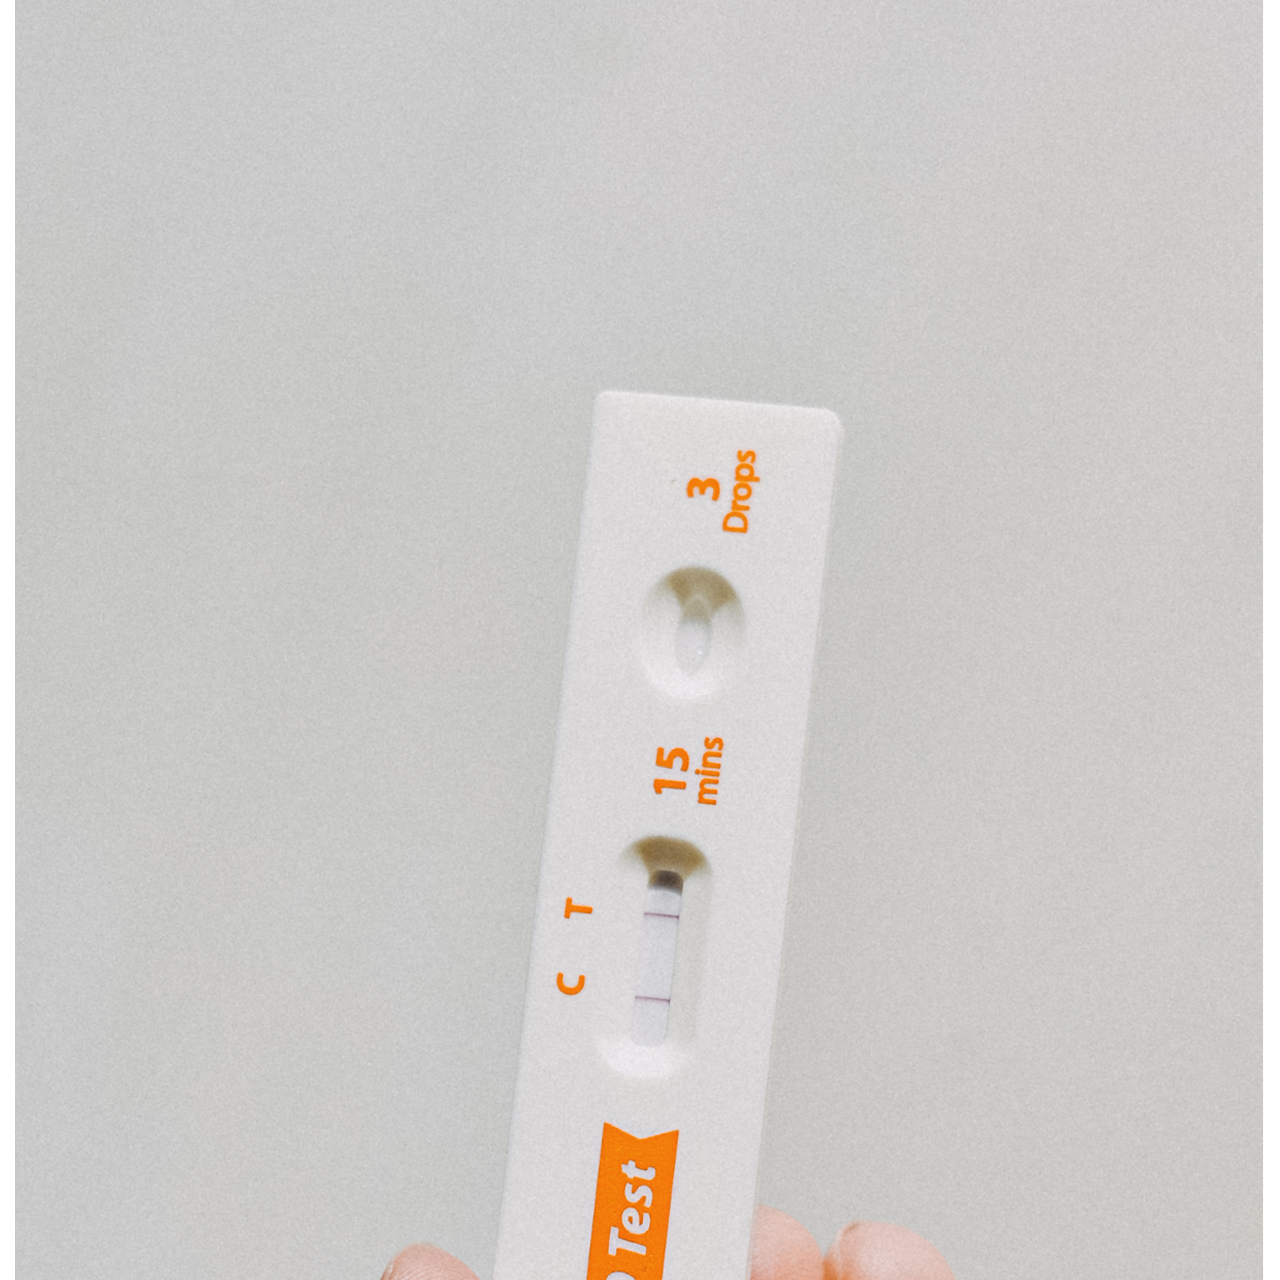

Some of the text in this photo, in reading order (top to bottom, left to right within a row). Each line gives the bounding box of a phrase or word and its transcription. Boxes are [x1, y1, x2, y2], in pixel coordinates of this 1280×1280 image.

[685, 476, 722, 503] 3
[721, 448, 761, 535] Drops
[652, 745, 691, 795] 15
[696, 736, 725, 806] mins
[562, 896, 594, 920] T
[555, 971, 587, 997] C
[607, 1159, 657, 1257] Test
